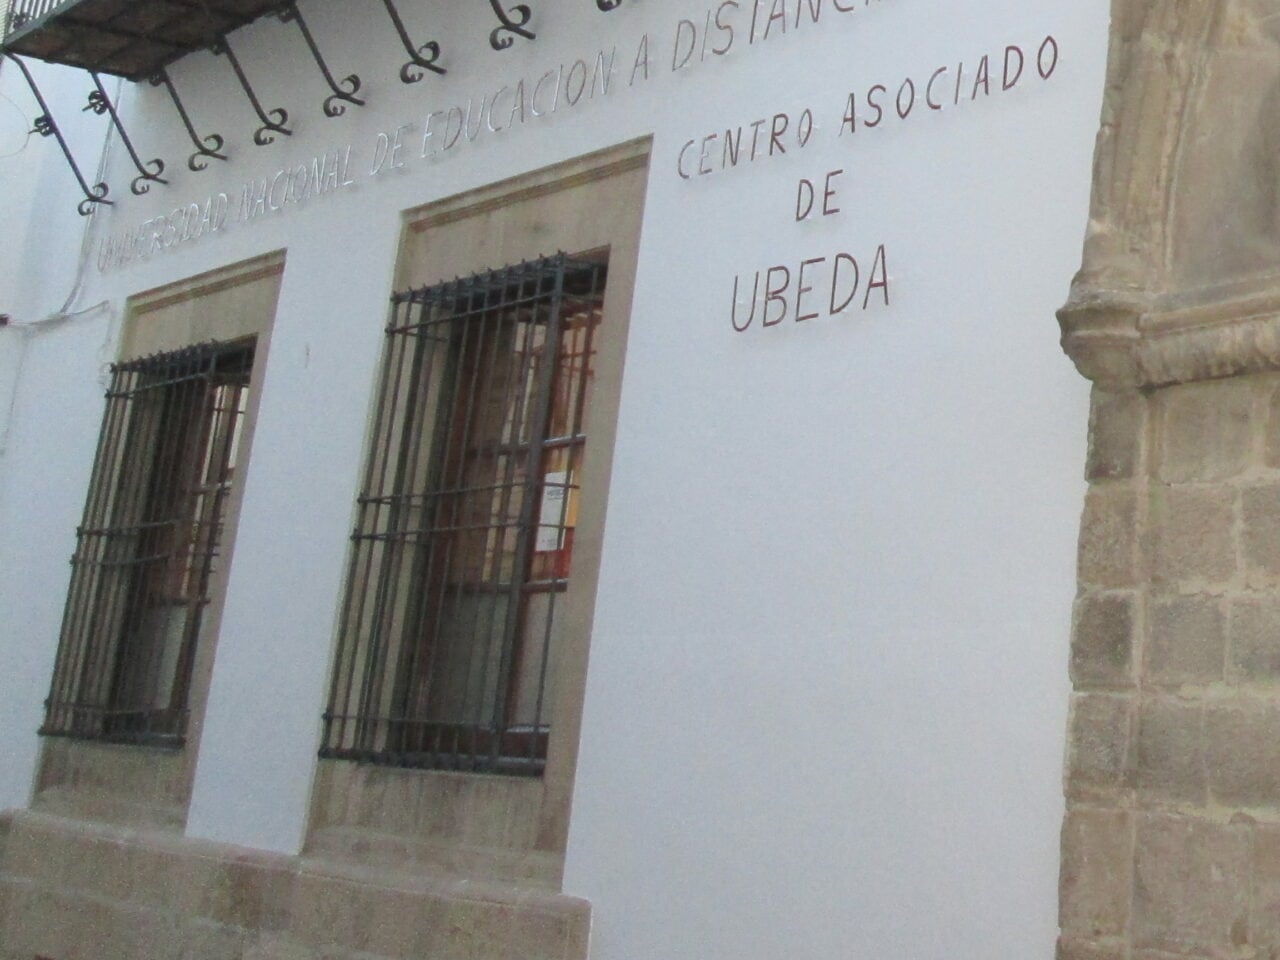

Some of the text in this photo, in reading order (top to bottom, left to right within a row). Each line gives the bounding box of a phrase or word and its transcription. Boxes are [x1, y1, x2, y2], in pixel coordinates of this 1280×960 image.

[238, 145, 353, 221] NACIONAL
[370, 124, 408, 176] DE
[421, 46, 616, 158] EDUCACION
[629, 33, 648, 86] A
[677, 36, 1058, 179] CENTRO ASOCIADO
[796, 169, 843, 221] DE
[731, 244, 889, 332] UBEDA
